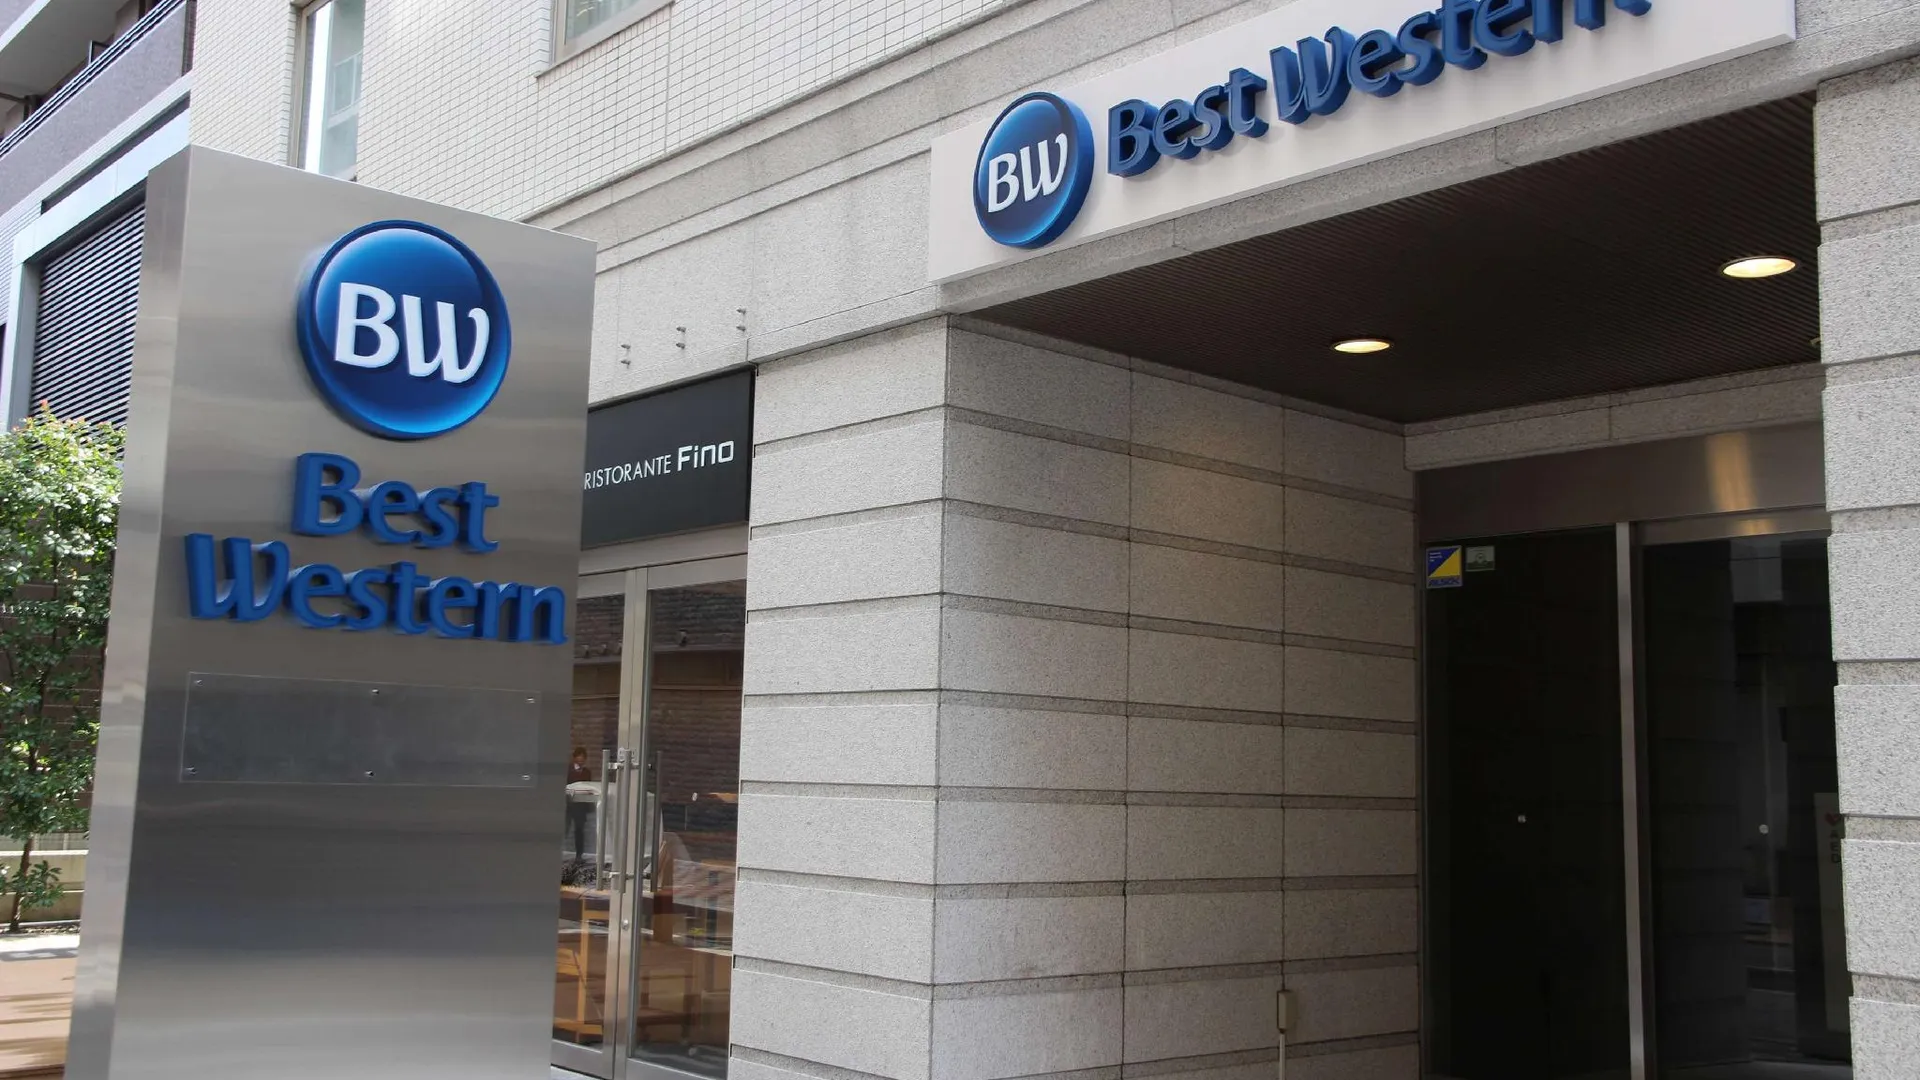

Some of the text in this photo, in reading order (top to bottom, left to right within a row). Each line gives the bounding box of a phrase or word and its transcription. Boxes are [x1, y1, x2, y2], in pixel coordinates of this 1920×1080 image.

[987, 132, 1069, 214] BW
[1107, 67, 1269, 178] Best
[333, 281, 492, 384] BW
[292, 452, 500, 554] Best
[584, 440, 735, 490] RISTORANTE Fino
[184, 532, 568, 645] Western
